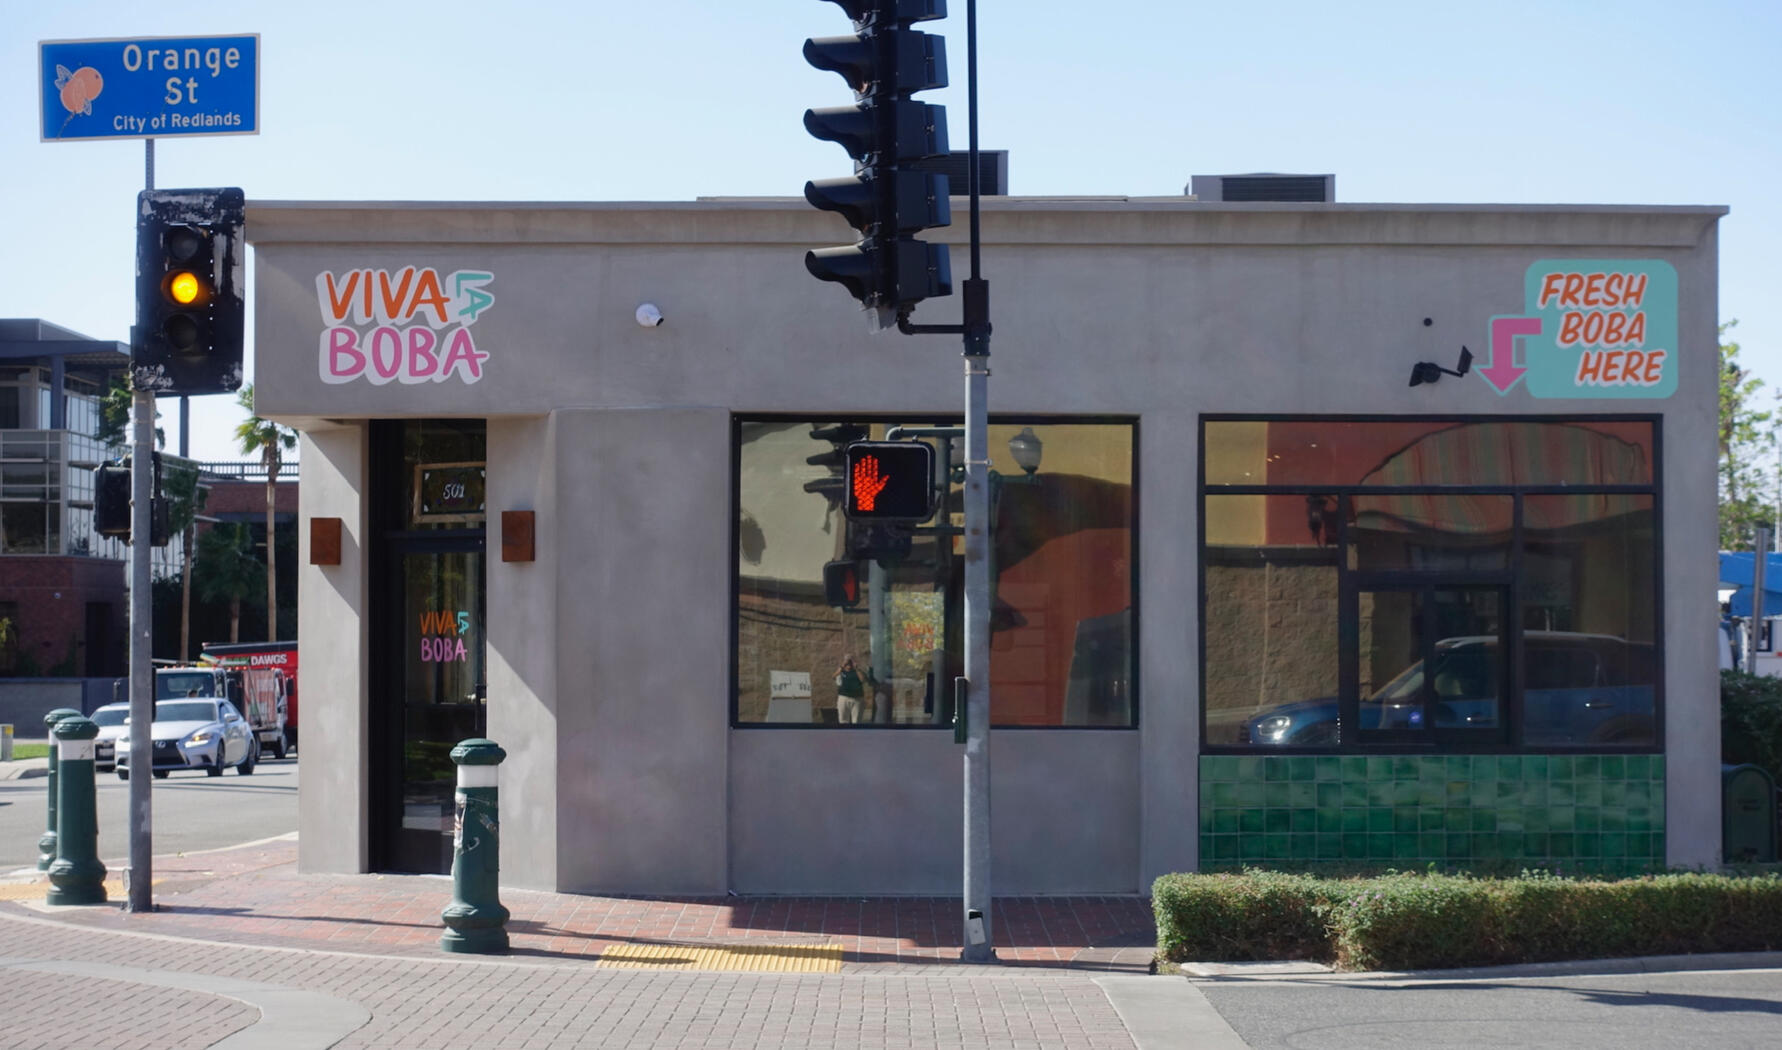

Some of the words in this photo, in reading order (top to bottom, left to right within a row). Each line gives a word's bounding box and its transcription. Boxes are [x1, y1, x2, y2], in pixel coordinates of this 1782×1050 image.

[122, 44, 241, 77] Orange
[164, 76, 198, 105] St
[112, 114, 146, 132] City
[150, 114, 166, 129] of
[171, 112, 241, 128] Redlands
[325, 267, 451, 323] VIVA
[1540, 273, 1647, 307] FRESH
[1560, 311, 1645, 344] BOBA
[329, 326, 489, 379] BOBA
[1578, 351, 1666, 383] HERE
[442, 482, 465, 500] 501
[419, 610, 457, 637] VIVA
[250, 653, 288, 667] DAWGS
[421, 637, 468, 663] BOBA
